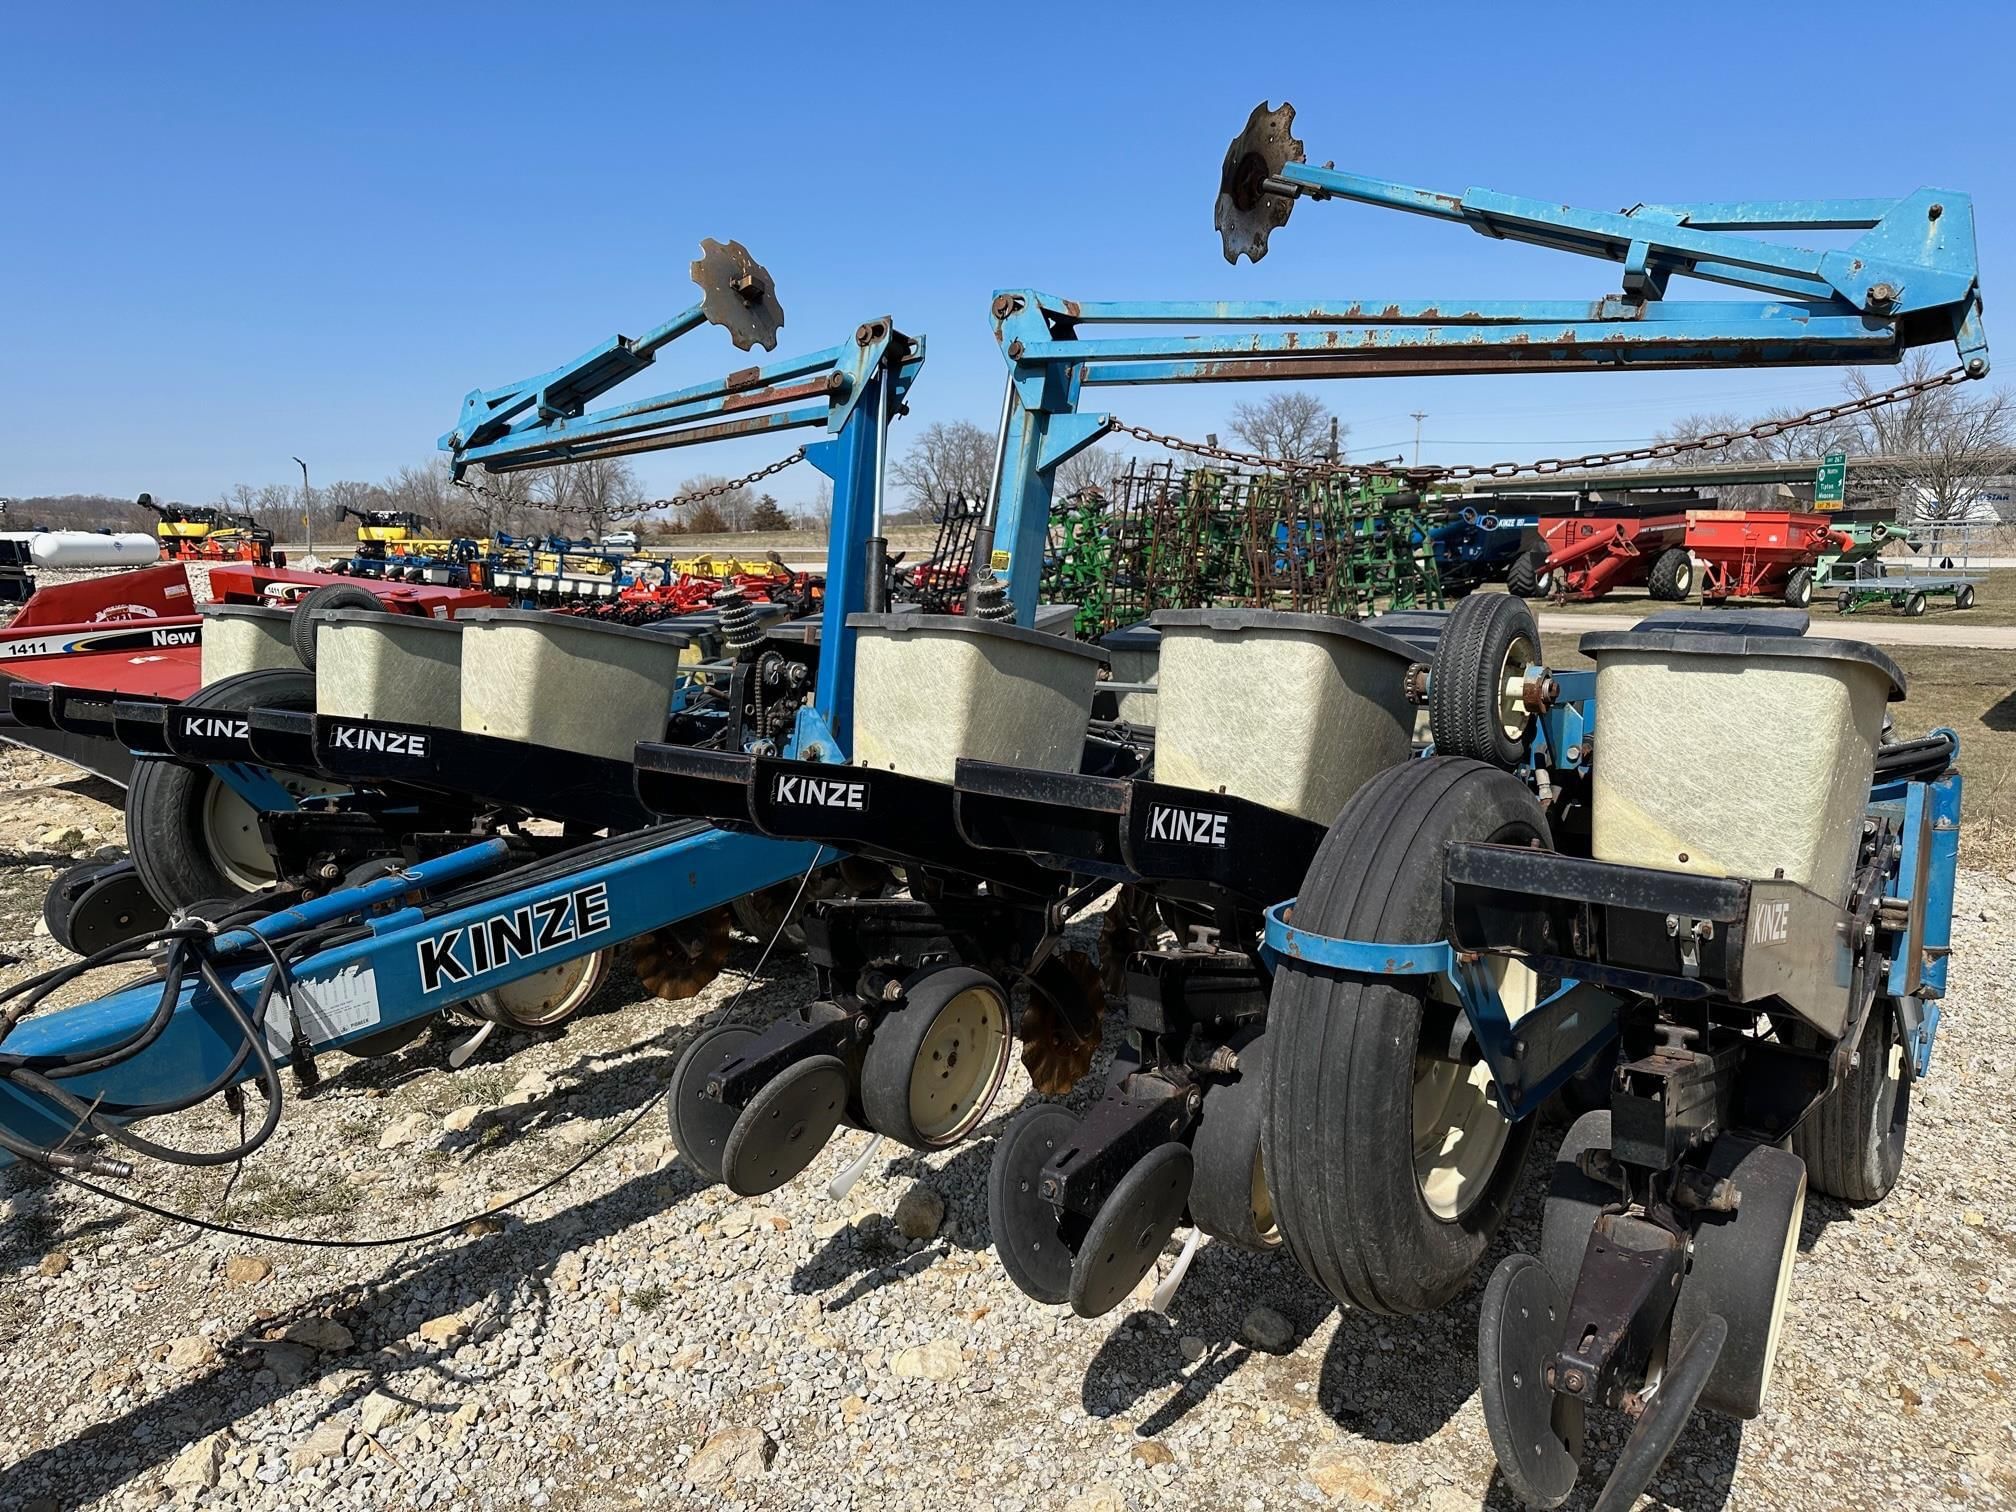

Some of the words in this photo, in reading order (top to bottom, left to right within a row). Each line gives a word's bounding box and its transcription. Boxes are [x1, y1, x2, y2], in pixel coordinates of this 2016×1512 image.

[1498, 518, 1516, 527] KINZE
[9, 642, 47, 655] 1411
[152, 631, 196, 647] New
[185, 717, 249, 739] KINZ
[335, 726, 425, 755] KINZE
[777, 776, 865, 808] KINZE
[1150, 806, 1228, 845] KINZE
[416, 881, 611, 994] KINZE
[1752, 903, 1790, 944] KINZE
